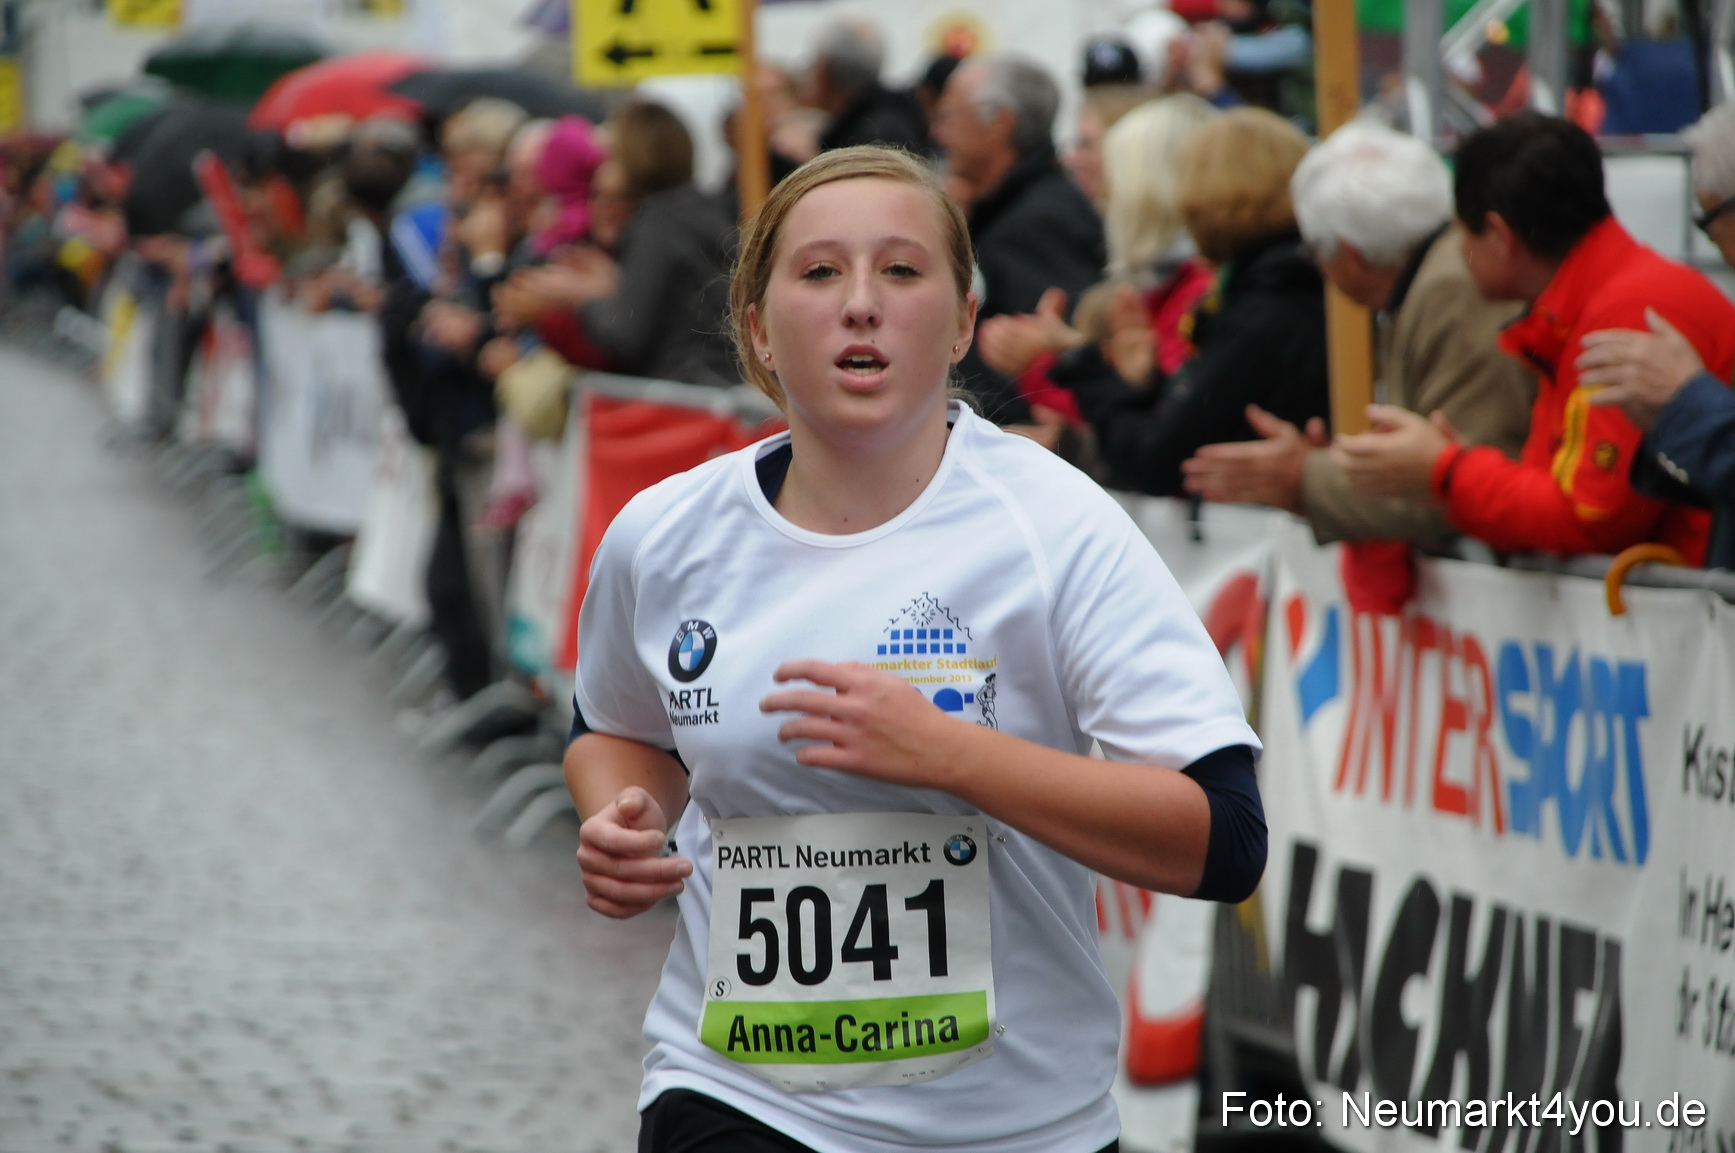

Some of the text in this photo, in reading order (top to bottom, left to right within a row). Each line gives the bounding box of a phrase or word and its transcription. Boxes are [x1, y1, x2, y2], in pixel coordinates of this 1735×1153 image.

[949, 674, 973, 683] 2013
[669, 687, 720, 710] ARTL
[1333, 605, 1653, 867] INTERSPORT
[717, 841, 931, 869] PARTL Neumarkt
[736, 878, 949, 986] 5041
[715, 980, 725, 998] S
[727, 1011, 960, 1053] Anna-Carina
